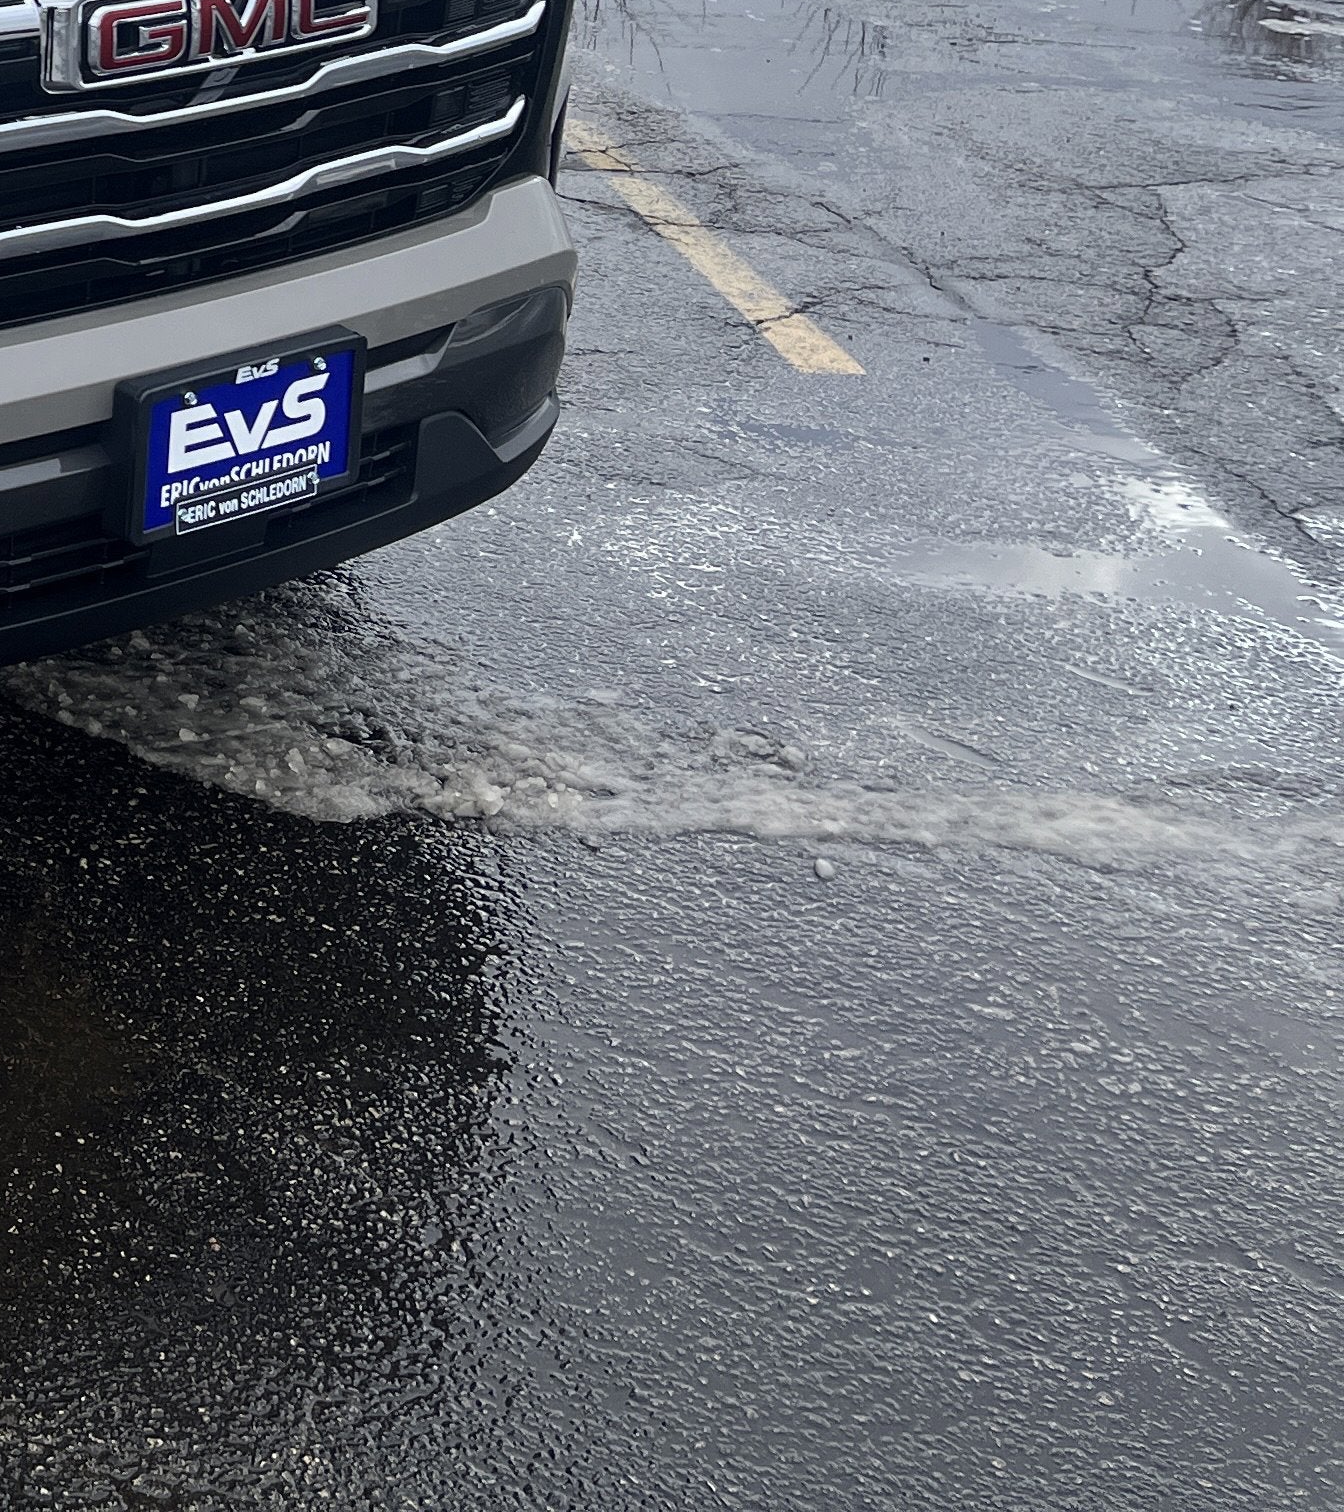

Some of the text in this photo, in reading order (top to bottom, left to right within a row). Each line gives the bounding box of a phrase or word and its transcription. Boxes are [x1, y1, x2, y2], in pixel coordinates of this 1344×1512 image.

[235, 357, 280, 384] EvS
[167, 372, 330, 474] EvS
[189, 474, 307, 523] ERIC von SCHLEDORN
